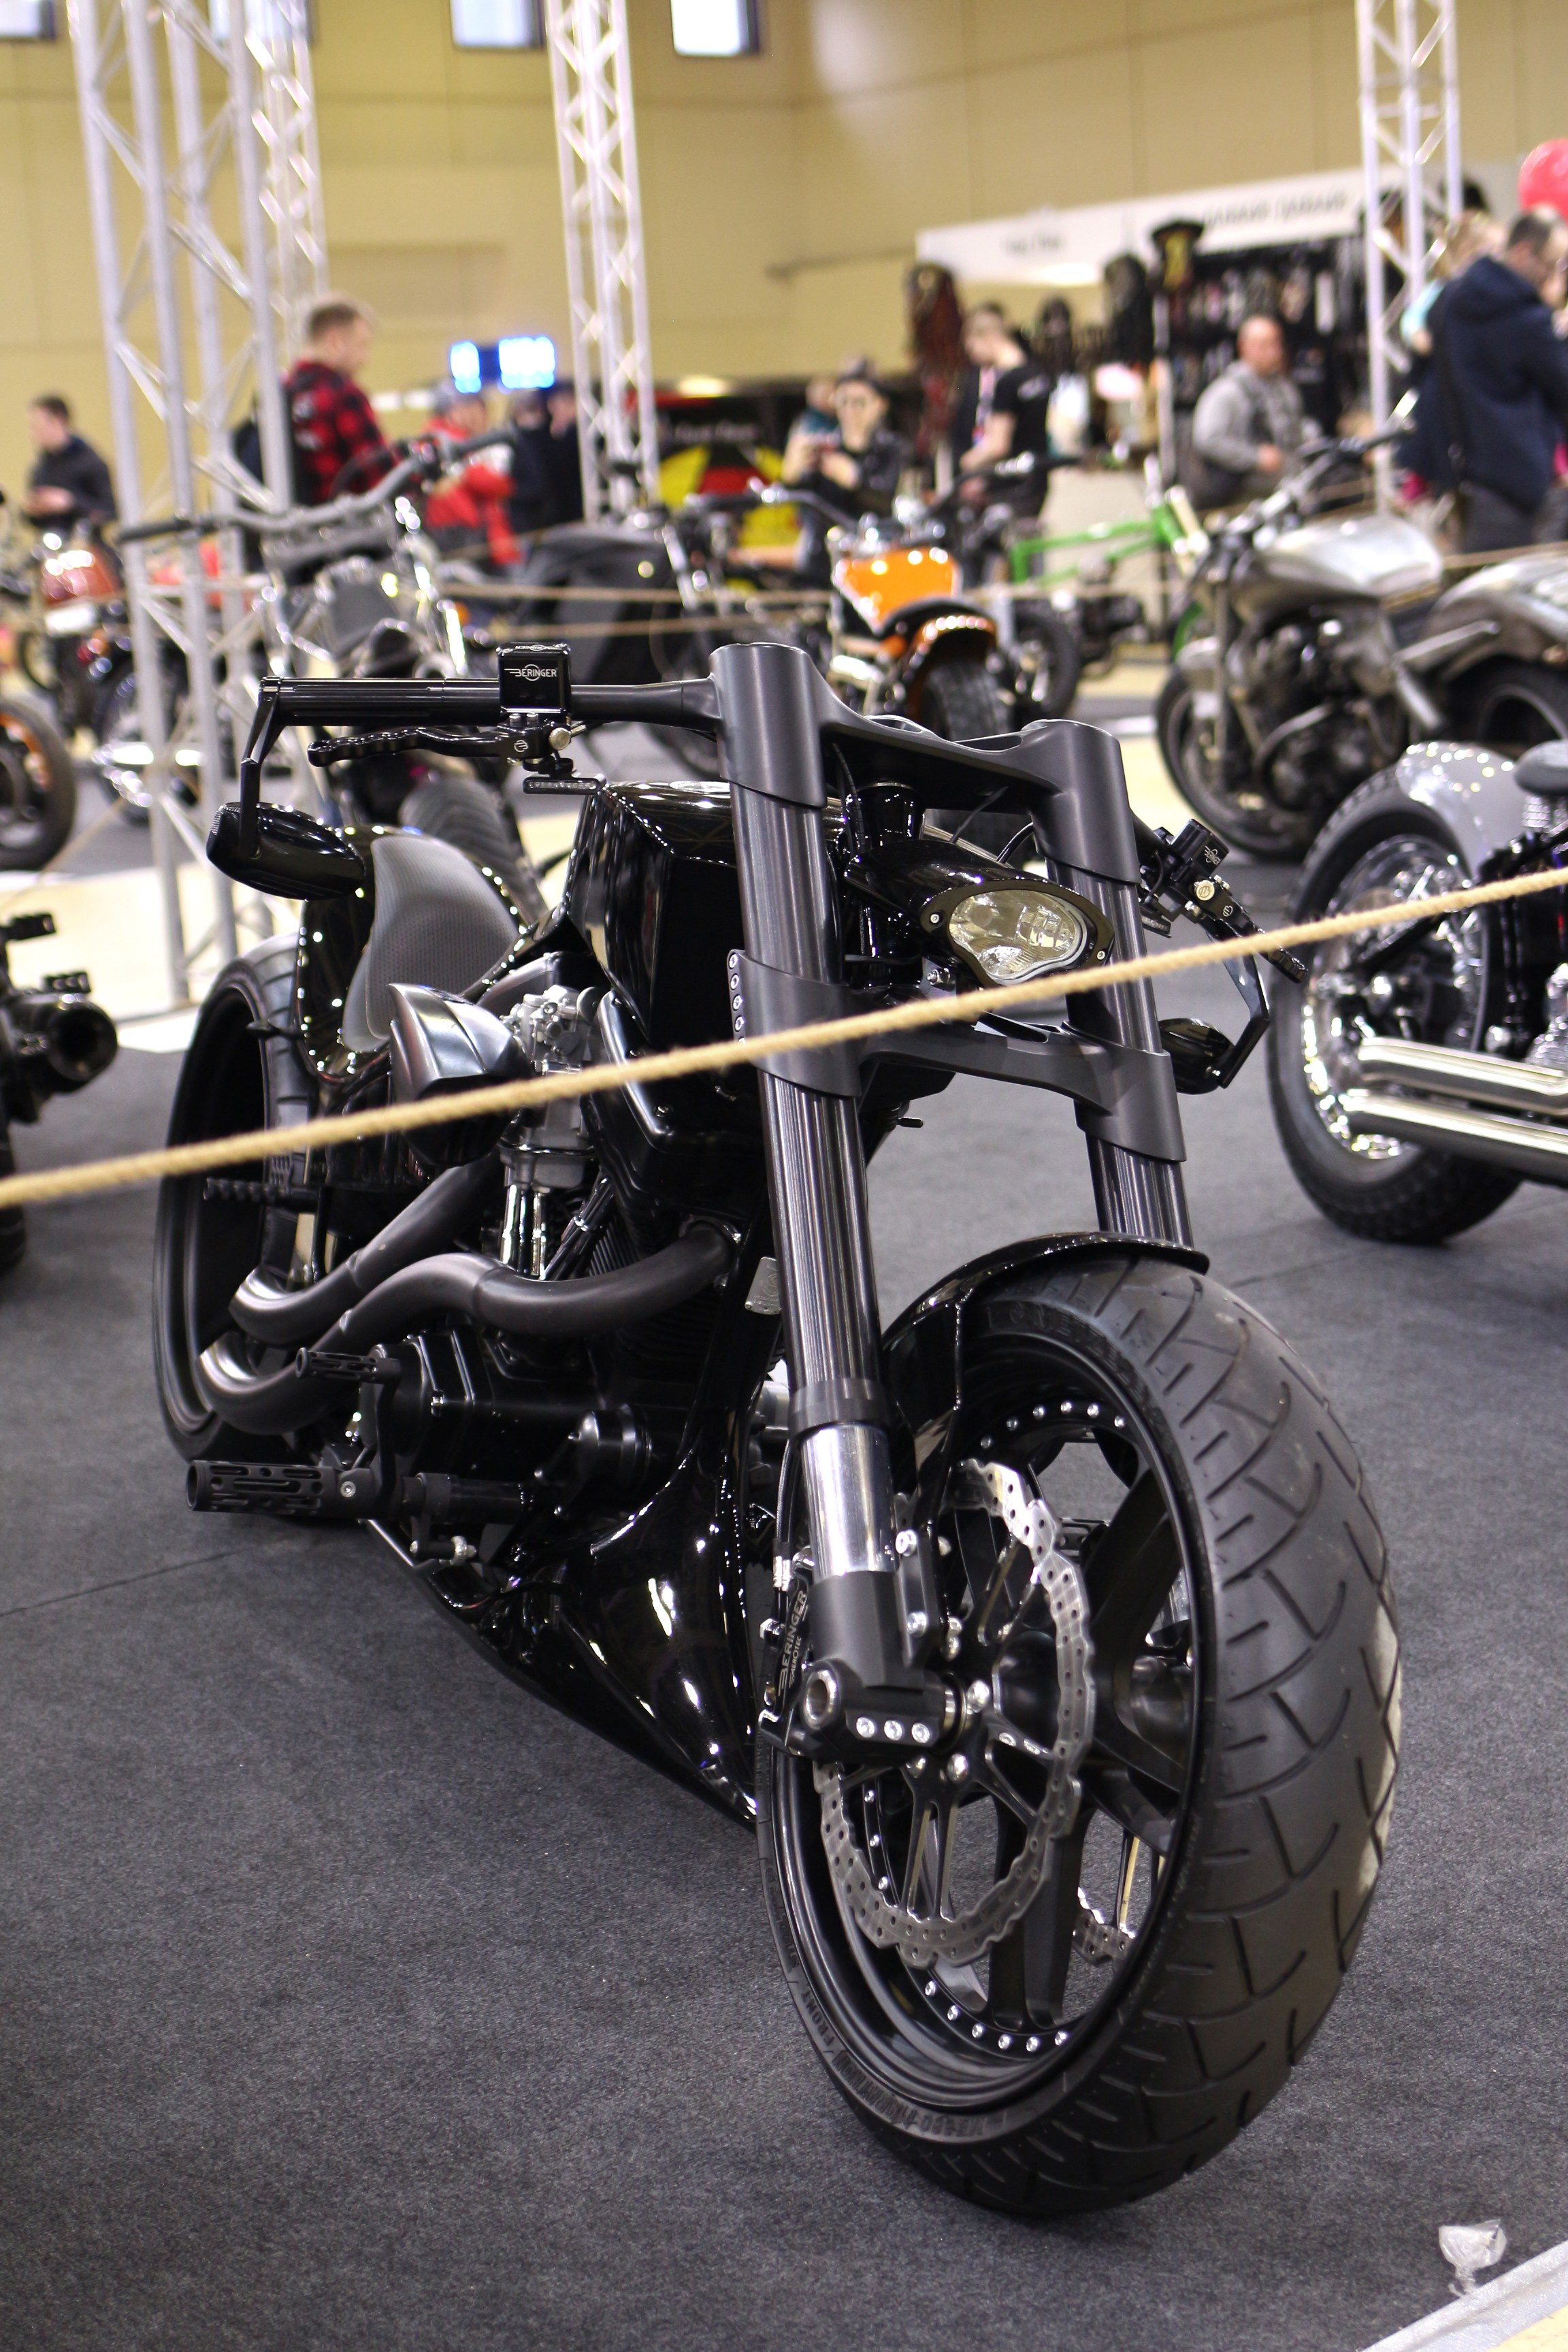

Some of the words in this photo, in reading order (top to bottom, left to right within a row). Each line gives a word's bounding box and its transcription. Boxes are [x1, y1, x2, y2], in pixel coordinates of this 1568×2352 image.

[504, 666, 557, 679] BERINGER
[779, 1590, 807, 1697] BERINGER
[789, 1635, 802, 1688] AEROTEC
[800, 1989, 835, 2047] FRONT
